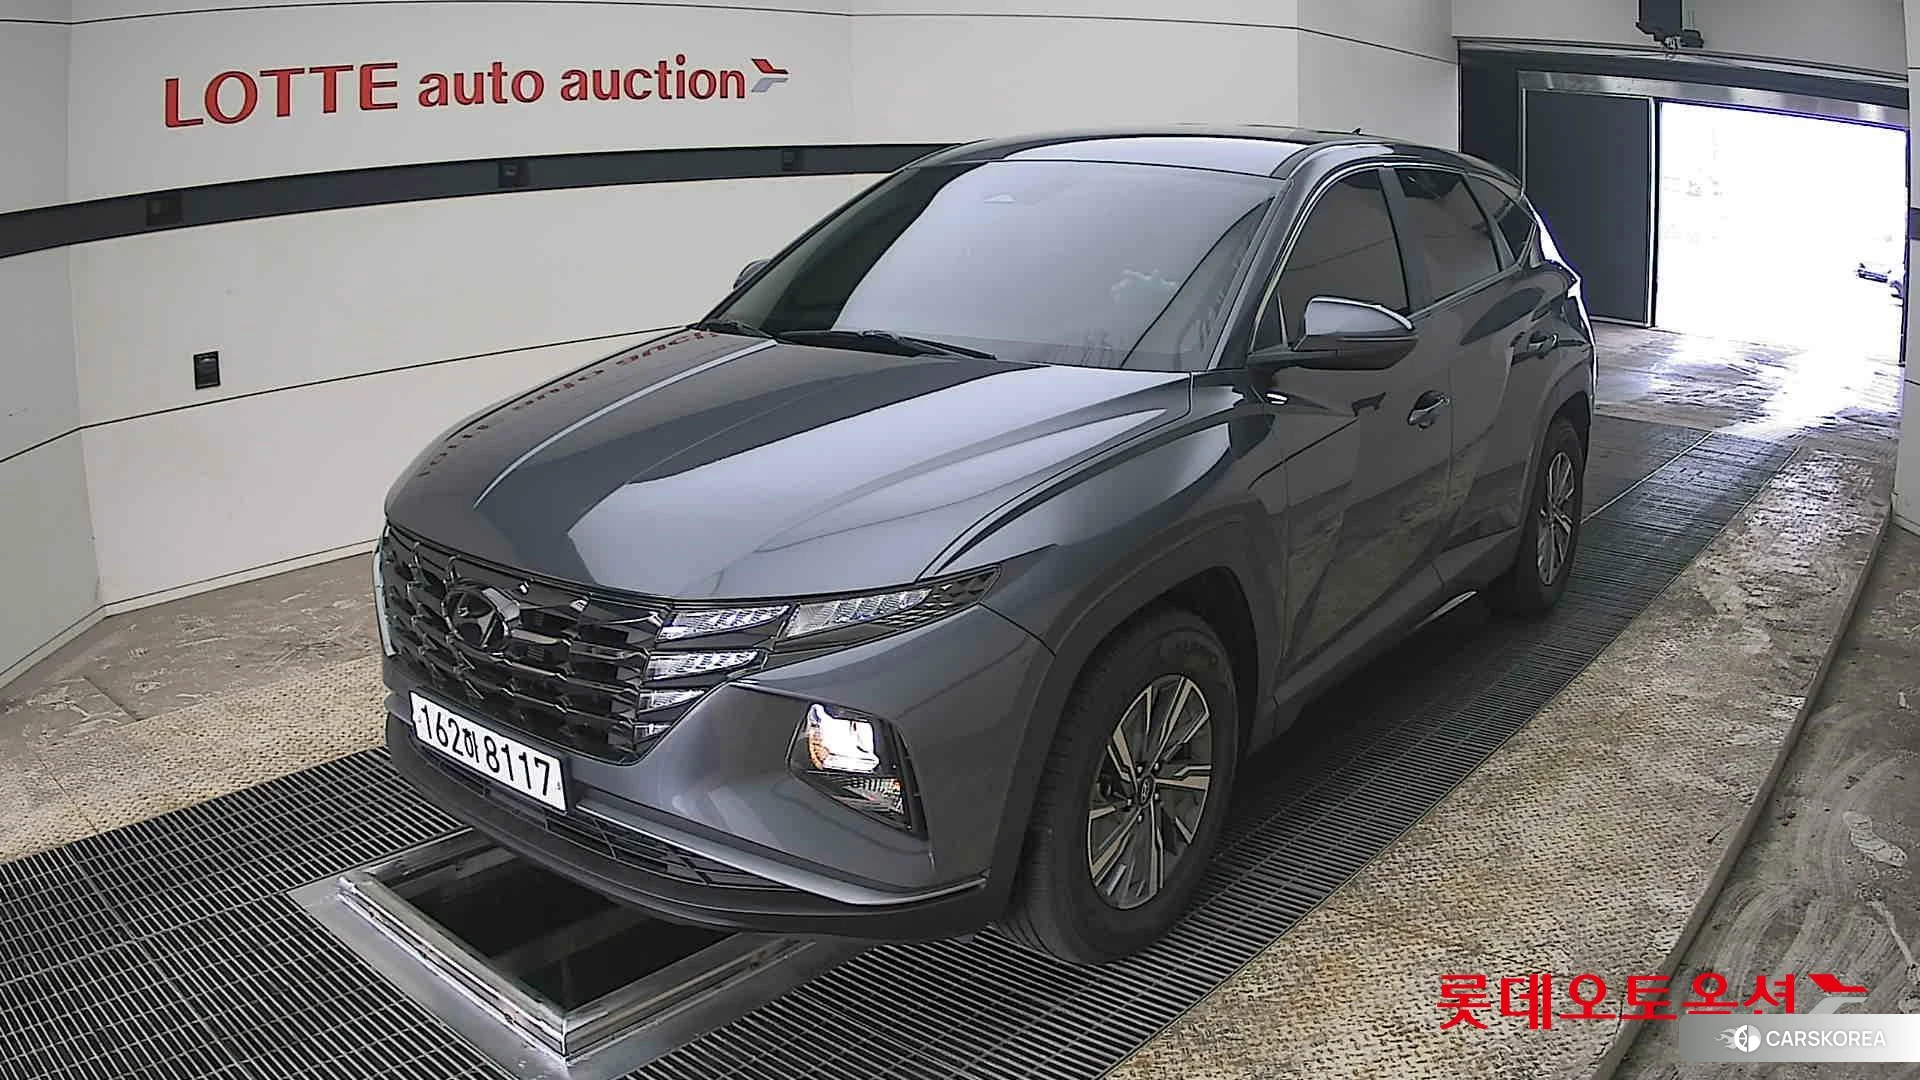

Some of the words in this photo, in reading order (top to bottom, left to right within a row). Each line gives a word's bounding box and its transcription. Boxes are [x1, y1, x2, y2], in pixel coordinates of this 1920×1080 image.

[164, 62, 398, 128] LOTTE
[418, 61, 544, 108] auto
[560, 54, 746, 101] auction
[484, 735, 551, 797] 8117
